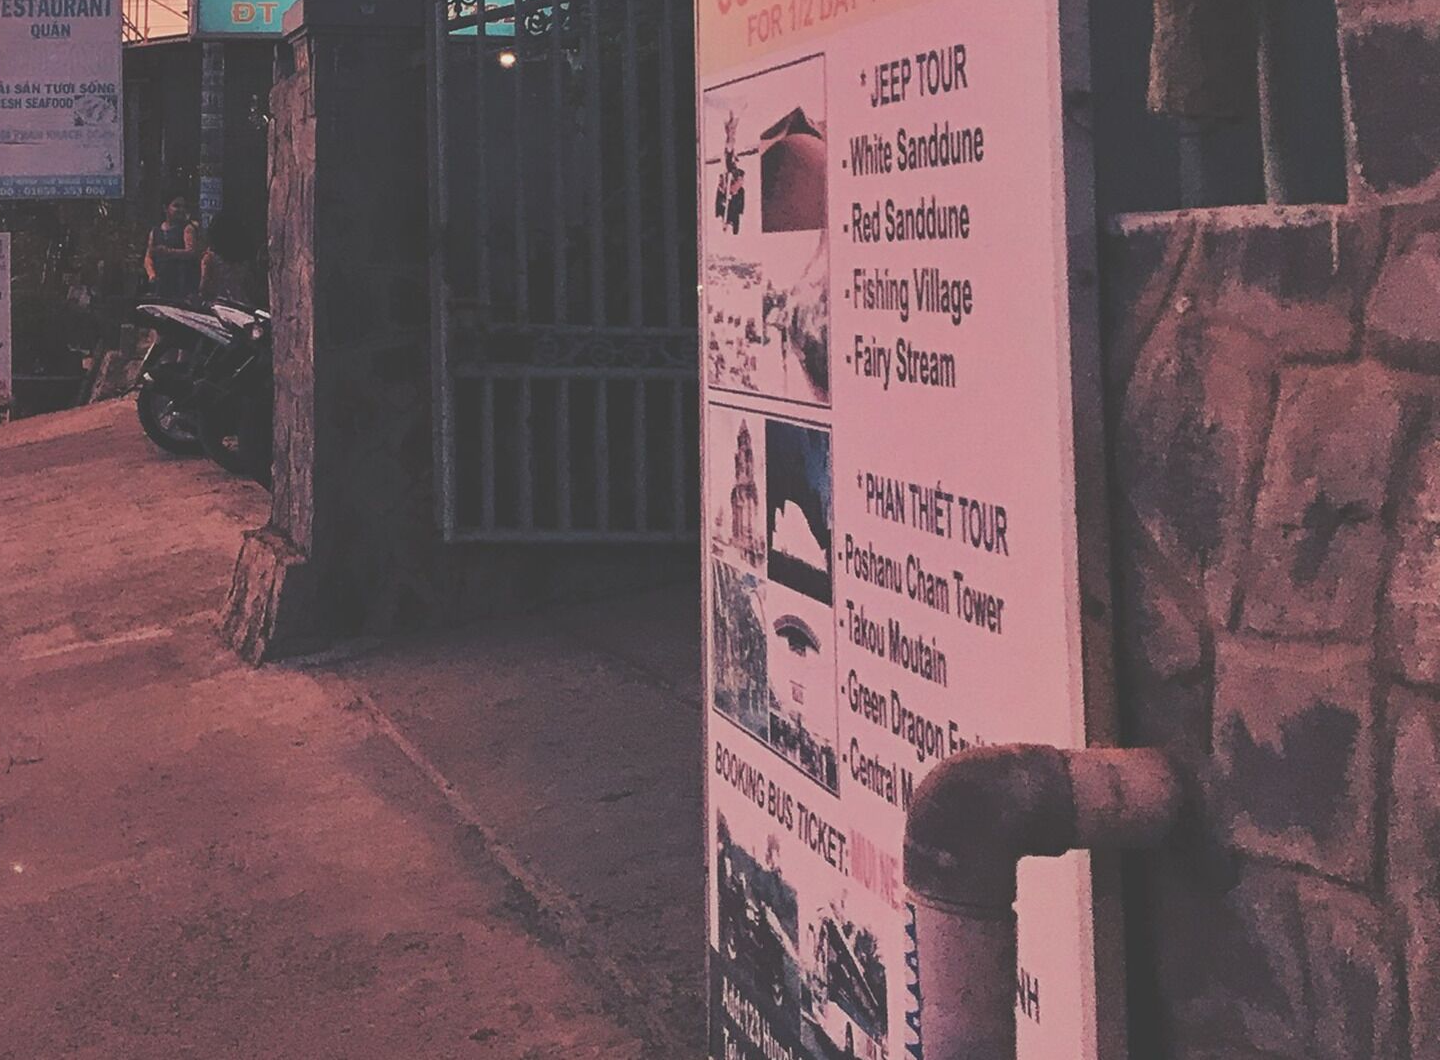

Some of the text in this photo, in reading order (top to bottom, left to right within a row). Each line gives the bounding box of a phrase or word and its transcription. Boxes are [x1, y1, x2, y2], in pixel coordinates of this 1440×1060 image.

[746, 1, 783, 47] FOR
[25, 98, 73, 109] SEAFOOD
[870, 43, 968, 108] JEEP TOUR
[849, 120, 985, 177] White Sanddune
[852, 195, 971, 244] Red Sanddune
[853, 267, 974, 326] Fishing Village
[854, 334, 957, 390] Fairy Stream
[865, 472, 1010, 557] PHAN THIẾT TOUR
[845, 533, 1005, 635] Poshanu Cham Tower
[846, 599, 948, 688] Takou Moutain
[848, 668, 888, 729] Green
[891, 688, 944, 763] Dragon
[715, 741, 765, 809] BOOKING
[767, 779, 794, 832] BUS
[849, 736, 899, 807] Central
